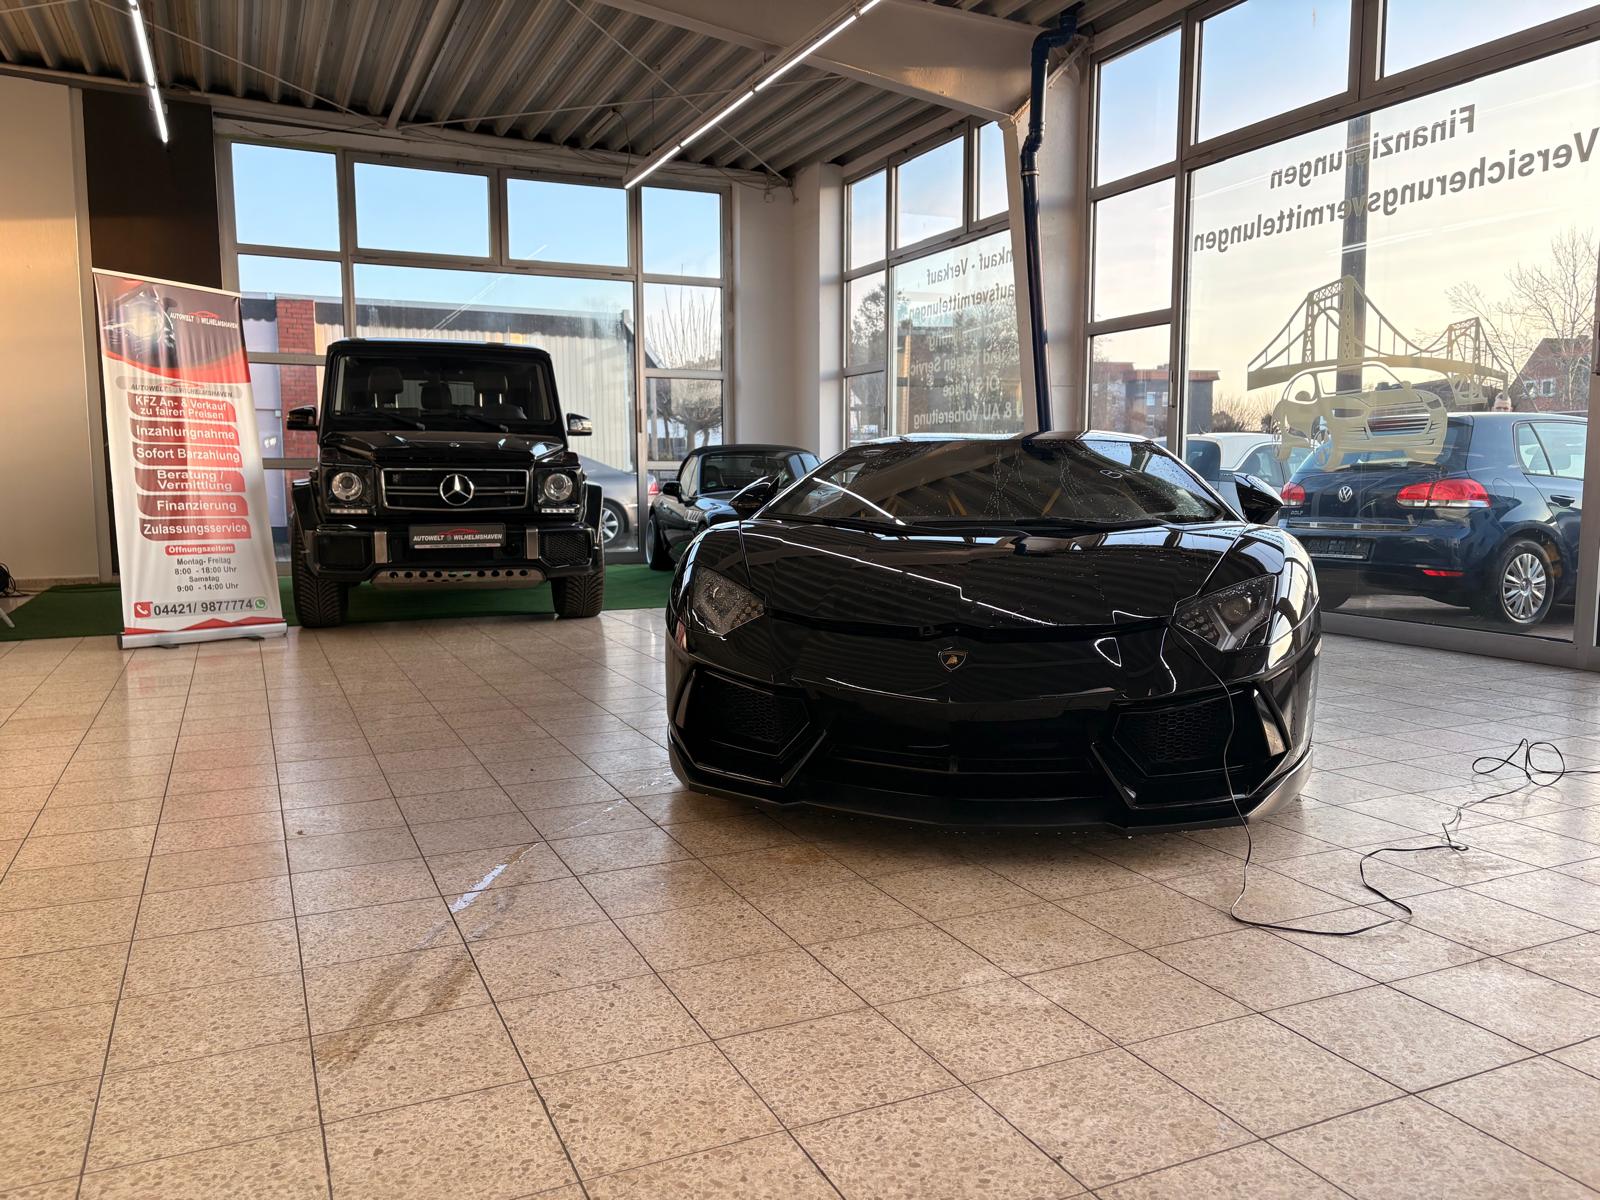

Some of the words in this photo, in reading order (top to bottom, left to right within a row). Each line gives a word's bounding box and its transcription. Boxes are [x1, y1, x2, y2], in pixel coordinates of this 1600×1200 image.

[170, 312, 194, 322] AUTOWELT
[201, 317, 239, 329] WILHELMSHAVEN
[135, 396, 157, 406] KFZ
[160, 397, 178, 406] An-
[181, 398, 188, 408] &
[191, 399, 227, 411] Verkauf
[140, 407, 153, 415] zu
[156, 407, 185, 416] fairen
[188, 408, 224, 419] Preisen
[136, 424, 235, 440] Inzahlungnahme
[136, 447, 174, 458] Sofort
[178, 448, 240, 463] Barzahlung
[157, 469, 217, 481] Beratung
[220, 471, 224, 480] /
[157, 480, 232, 491] Vermittlung
[157, 500, 237, 512] Finanzierung
[143, 523, 247, 535] Zulassungsservice
[168, 544, 233, 554] Öffnungszeiten:
[177, 558, 206, 567] Montag-
[208, 557, 231, 565] Freitag
[177, 584, 194, 592] 9:00
[153, 603, 196, 616] 04421/
[201, 599, 253, 612] 9877774
